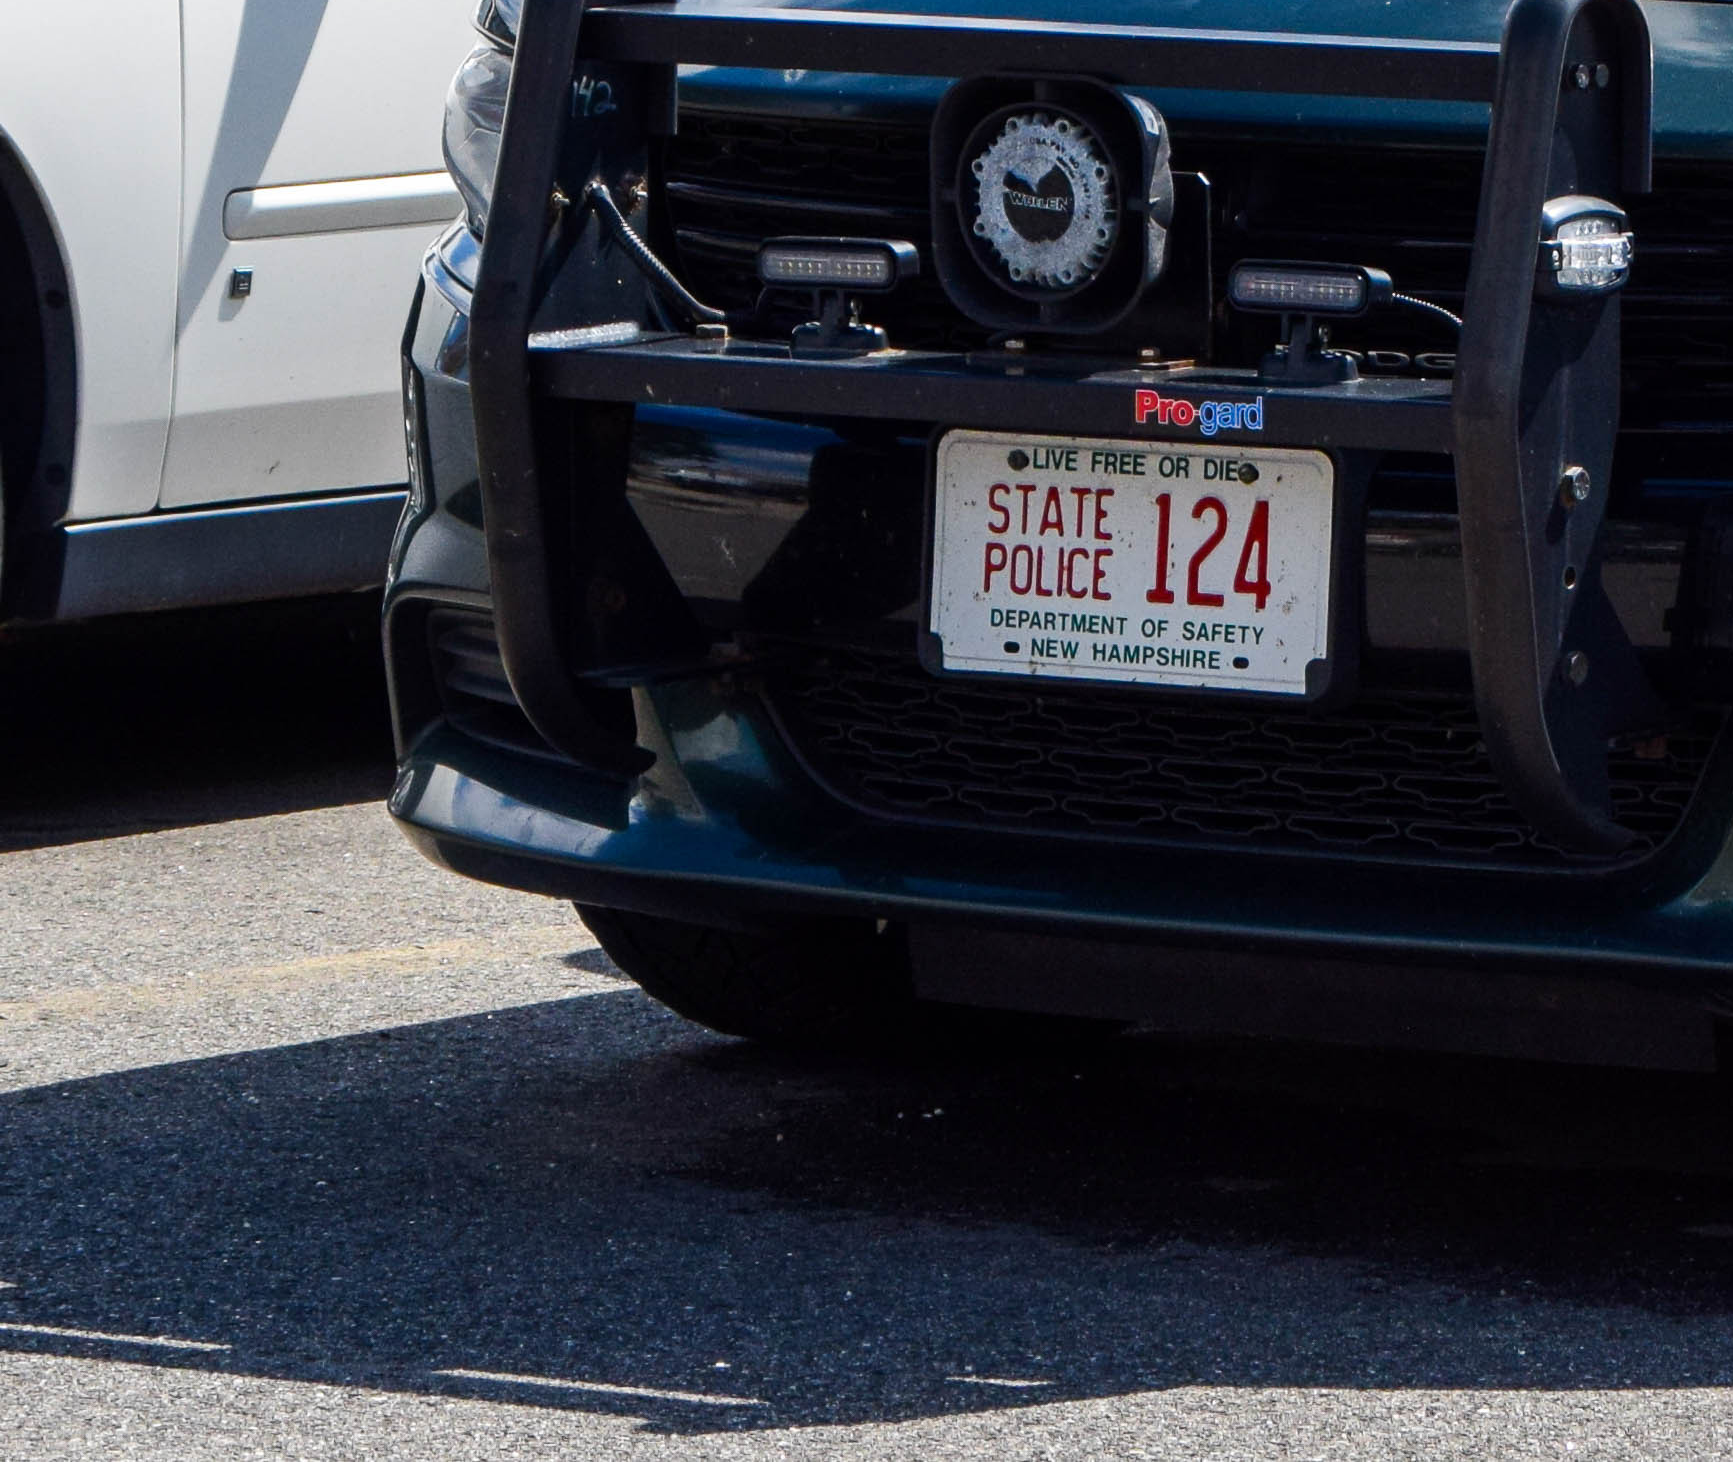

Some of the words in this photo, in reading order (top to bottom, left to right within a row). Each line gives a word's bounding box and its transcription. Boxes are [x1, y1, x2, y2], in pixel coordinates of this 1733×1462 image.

[1135, 389, 1263, 436] Pro-gard
[1032, 449, 1077, 472] LIVE
[1090, 452, 1146, 475] FREE
[1159, 455, 1189, 479] OR
[1204, 458, 1238, 481] DIE
[988, 483, 1115, 540] STATE
[983, 542, 1113, 601] POLICE
[1146, 492, 1271, 610] 124
[990, 608, 1127, 637] DEPARTMENT
[1141, 618, 1168, 639] OF
[1182, 620, 1264, 645] SAFETY
[1031, 639, 1079, 659] NEW
[1093, 643, 1221, 670] HAMPSHIRE
